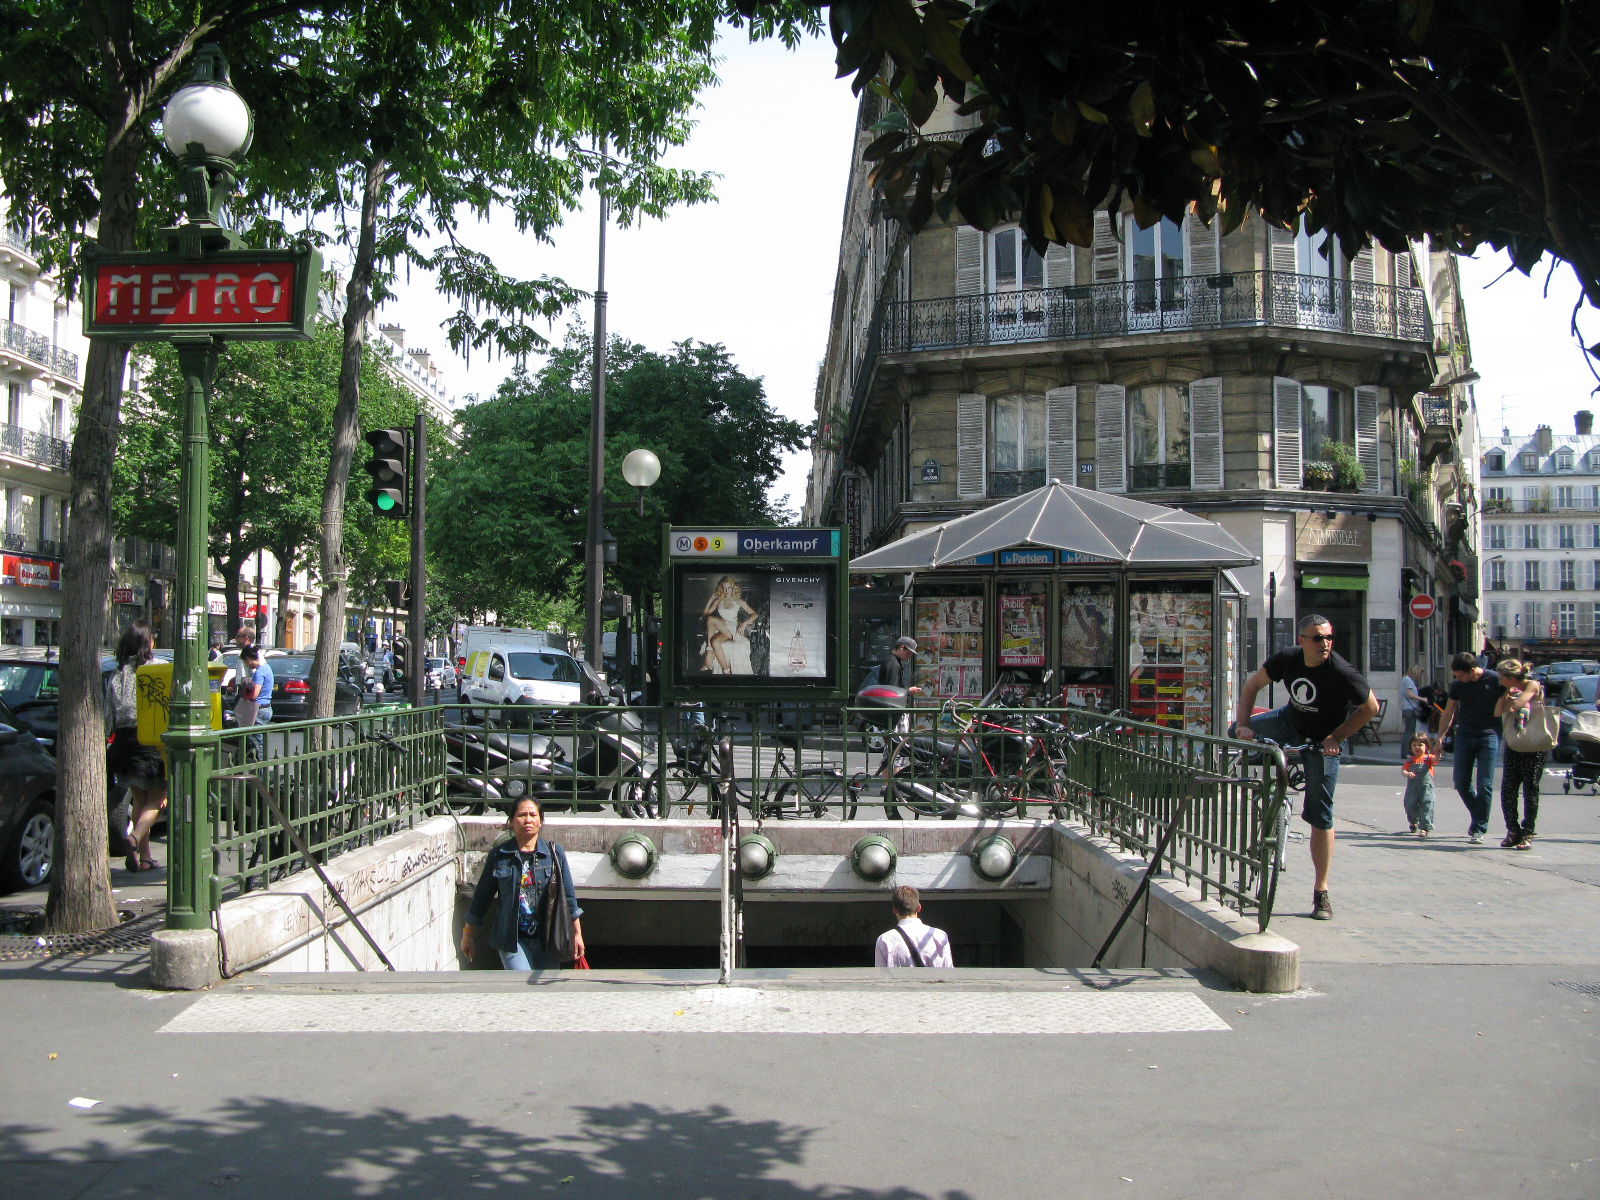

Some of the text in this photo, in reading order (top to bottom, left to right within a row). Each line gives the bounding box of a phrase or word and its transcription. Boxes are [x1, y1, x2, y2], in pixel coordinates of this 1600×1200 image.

[108, 272, 282, 316] METRO
[1081, 464, 1092, 473] 20
[714, 539, 721, 549] 9
[743, 537, 819, 552] Oberkampf
[1012, 552, 1048, 564] Parisien
[115, 591, 132, 603] SFR
[1003, 599, 1025, 609] Public
